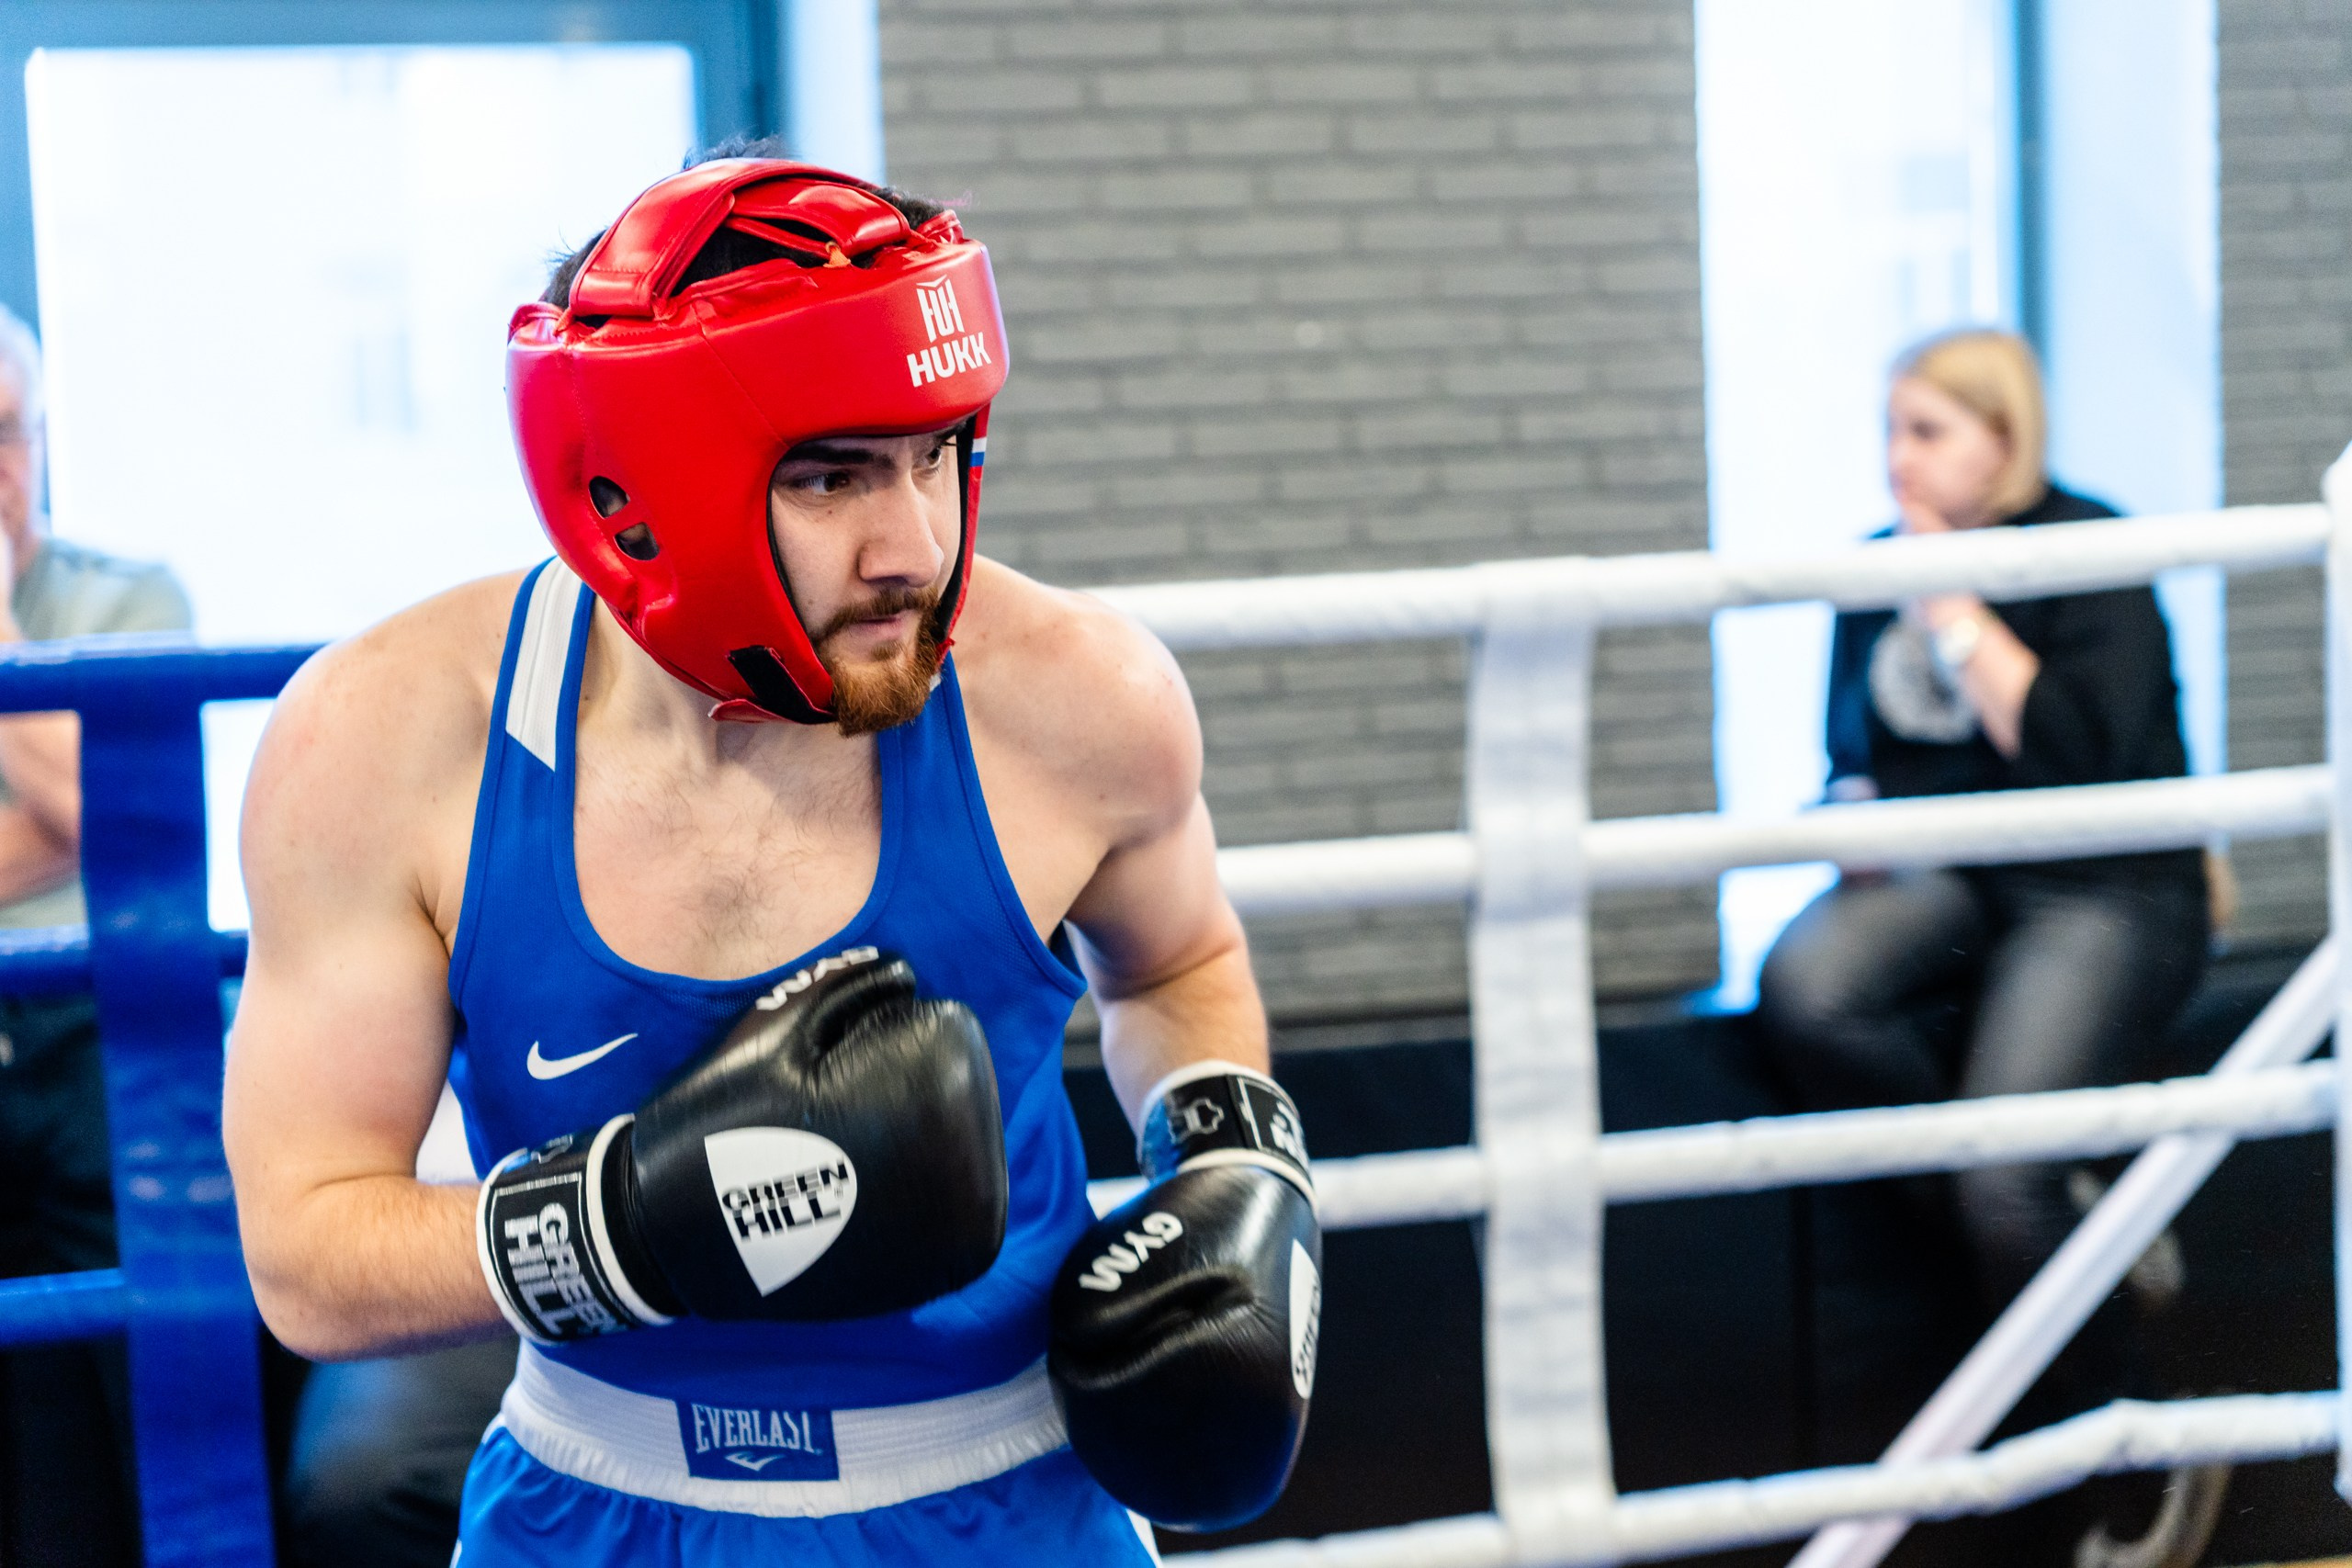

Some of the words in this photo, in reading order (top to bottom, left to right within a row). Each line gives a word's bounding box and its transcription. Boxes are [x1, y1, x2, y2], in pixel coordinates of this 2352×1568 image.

[906, 332, 992, 388] HUKK
[722, 1159, 849, 1217] GREEN
[733, 1190, 842, 1240] HILL
[504, 1214, 584, 1335] HILL
[1078, 1211, 1183, 1292] GYM
